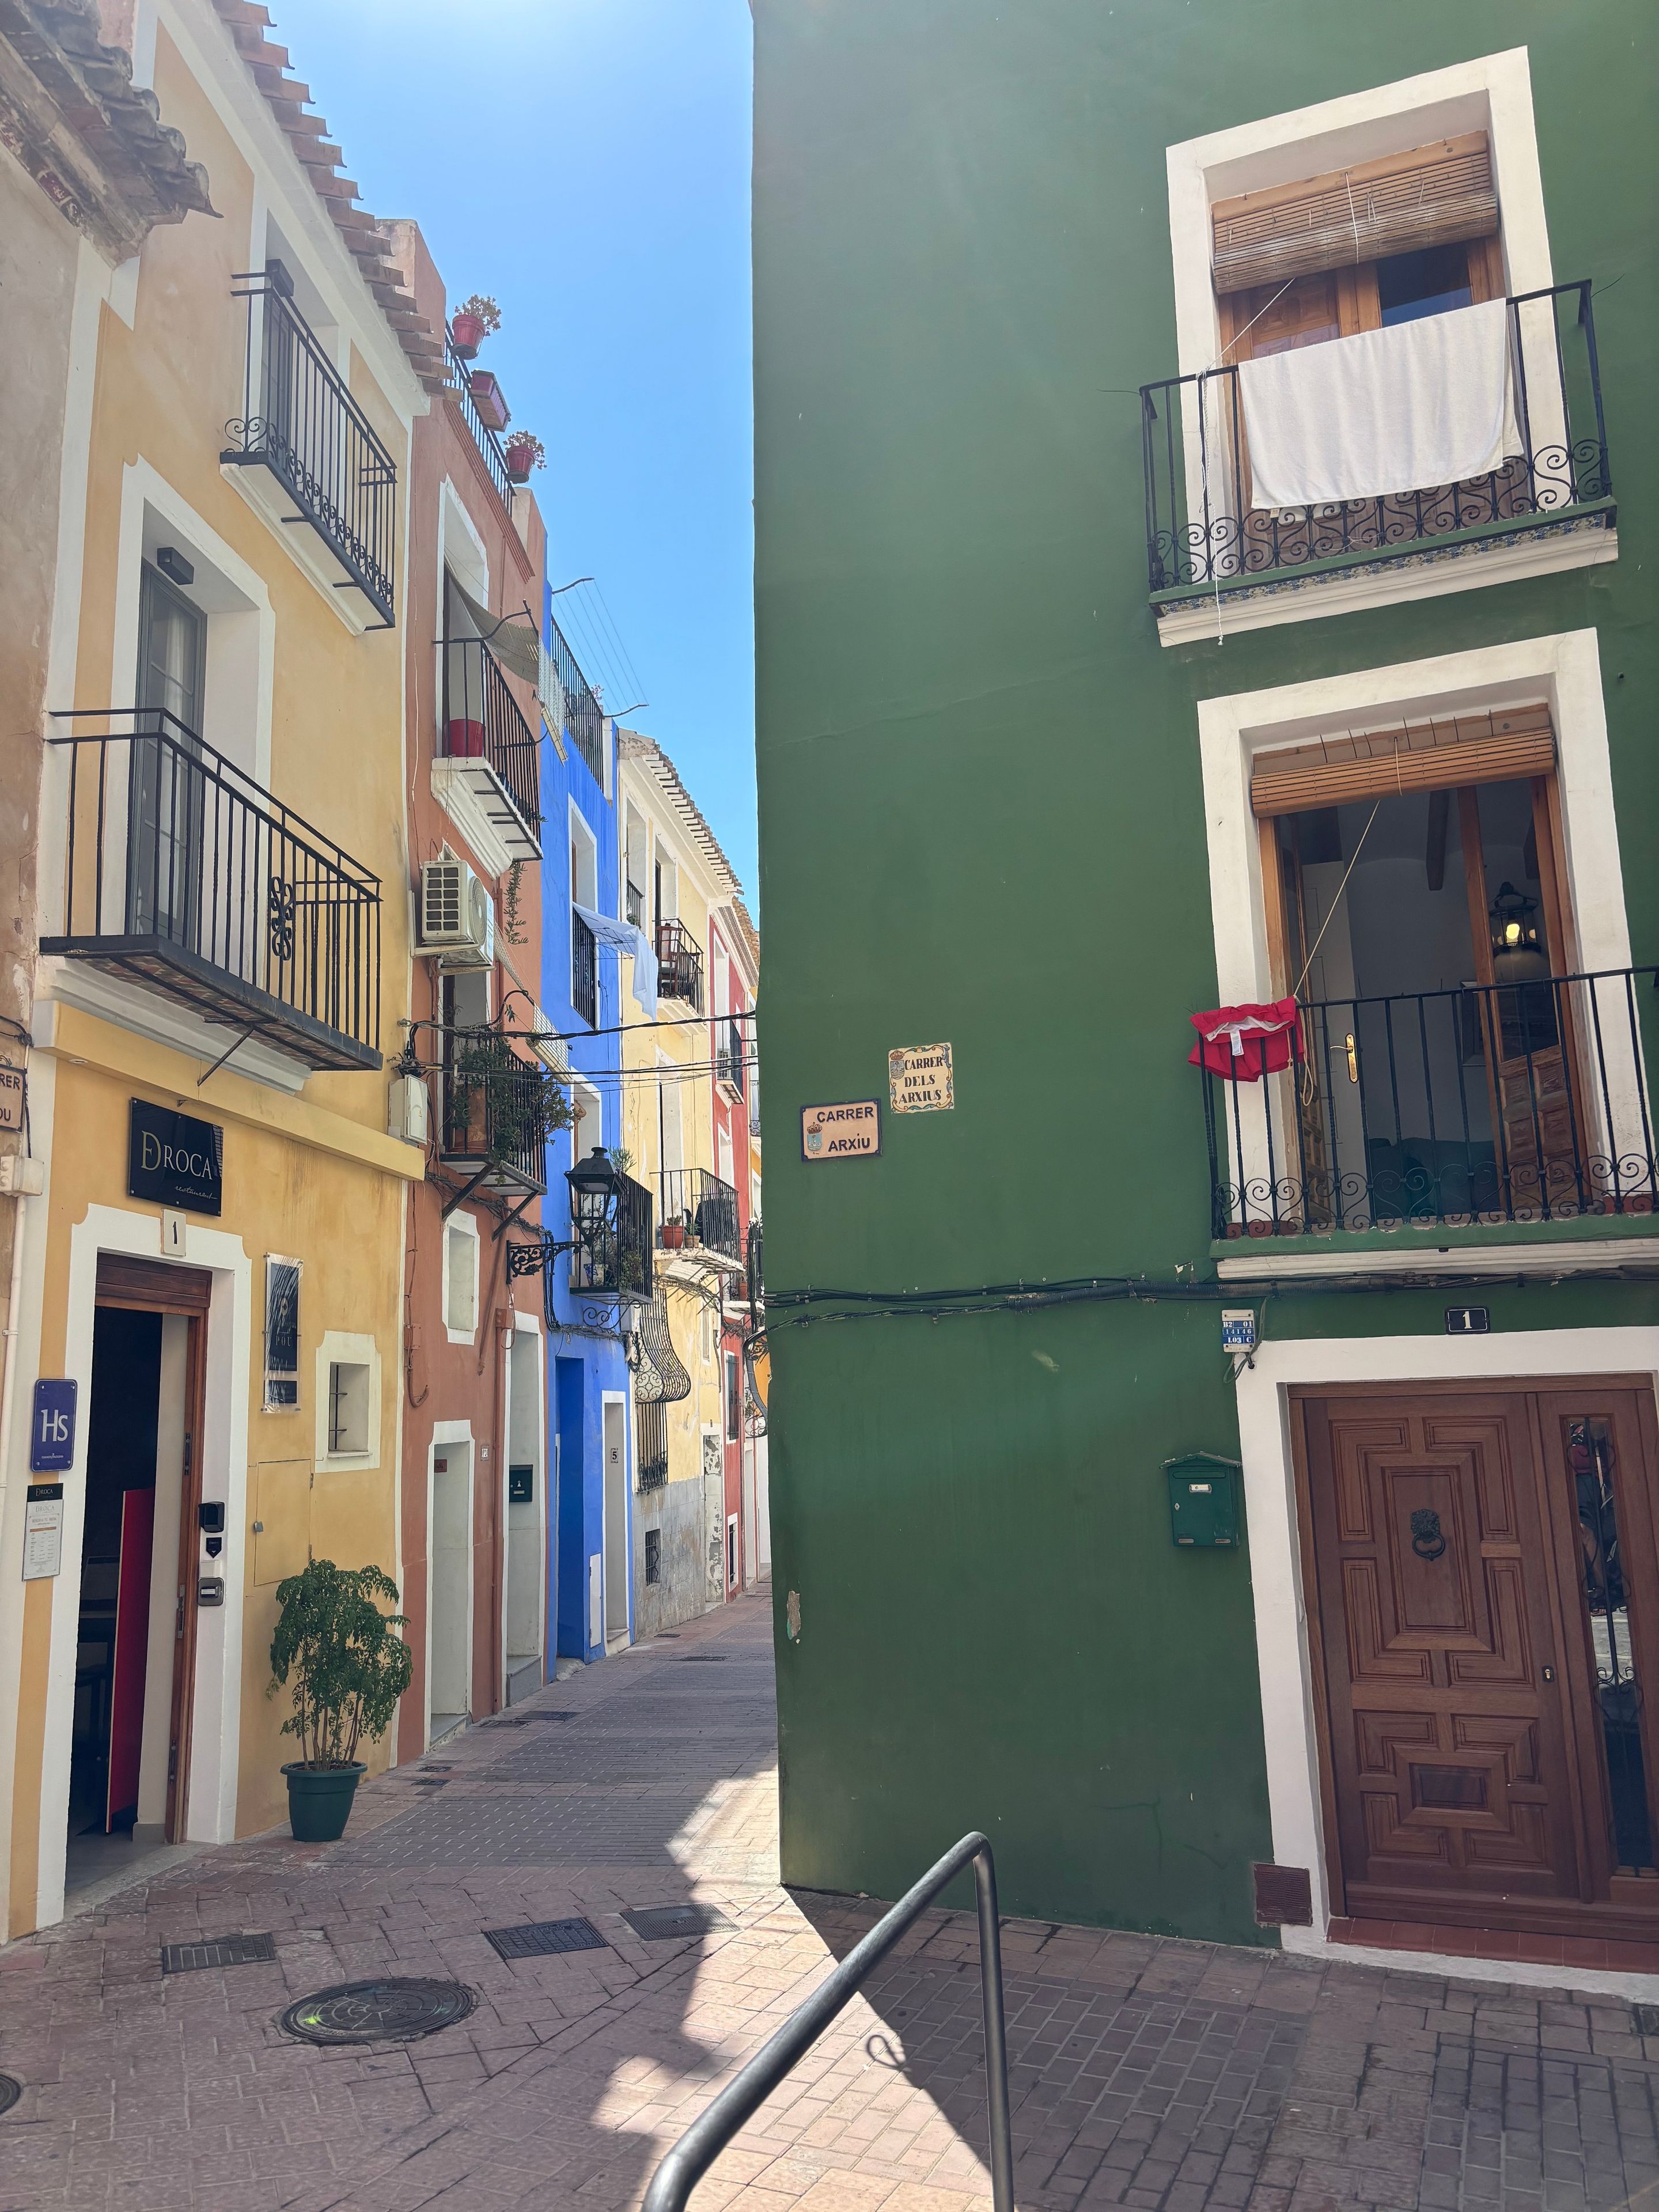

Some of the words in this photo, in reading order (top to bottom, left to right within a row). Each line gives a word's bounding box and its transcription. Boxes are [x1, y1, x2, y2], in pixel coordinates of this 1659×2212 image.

[904, 1056, 943, 1070] CARRER
[904, 1074, 935, 1088] DELS
[899, 1089, 941, 1104] ARXIUS
[817, 1107, 874, 1123] CARRER
[172, 1221, 177, 1245] 1
[1462, 1310, 1472, 1329] 1
[612, 1451, 617, 1460] 5
